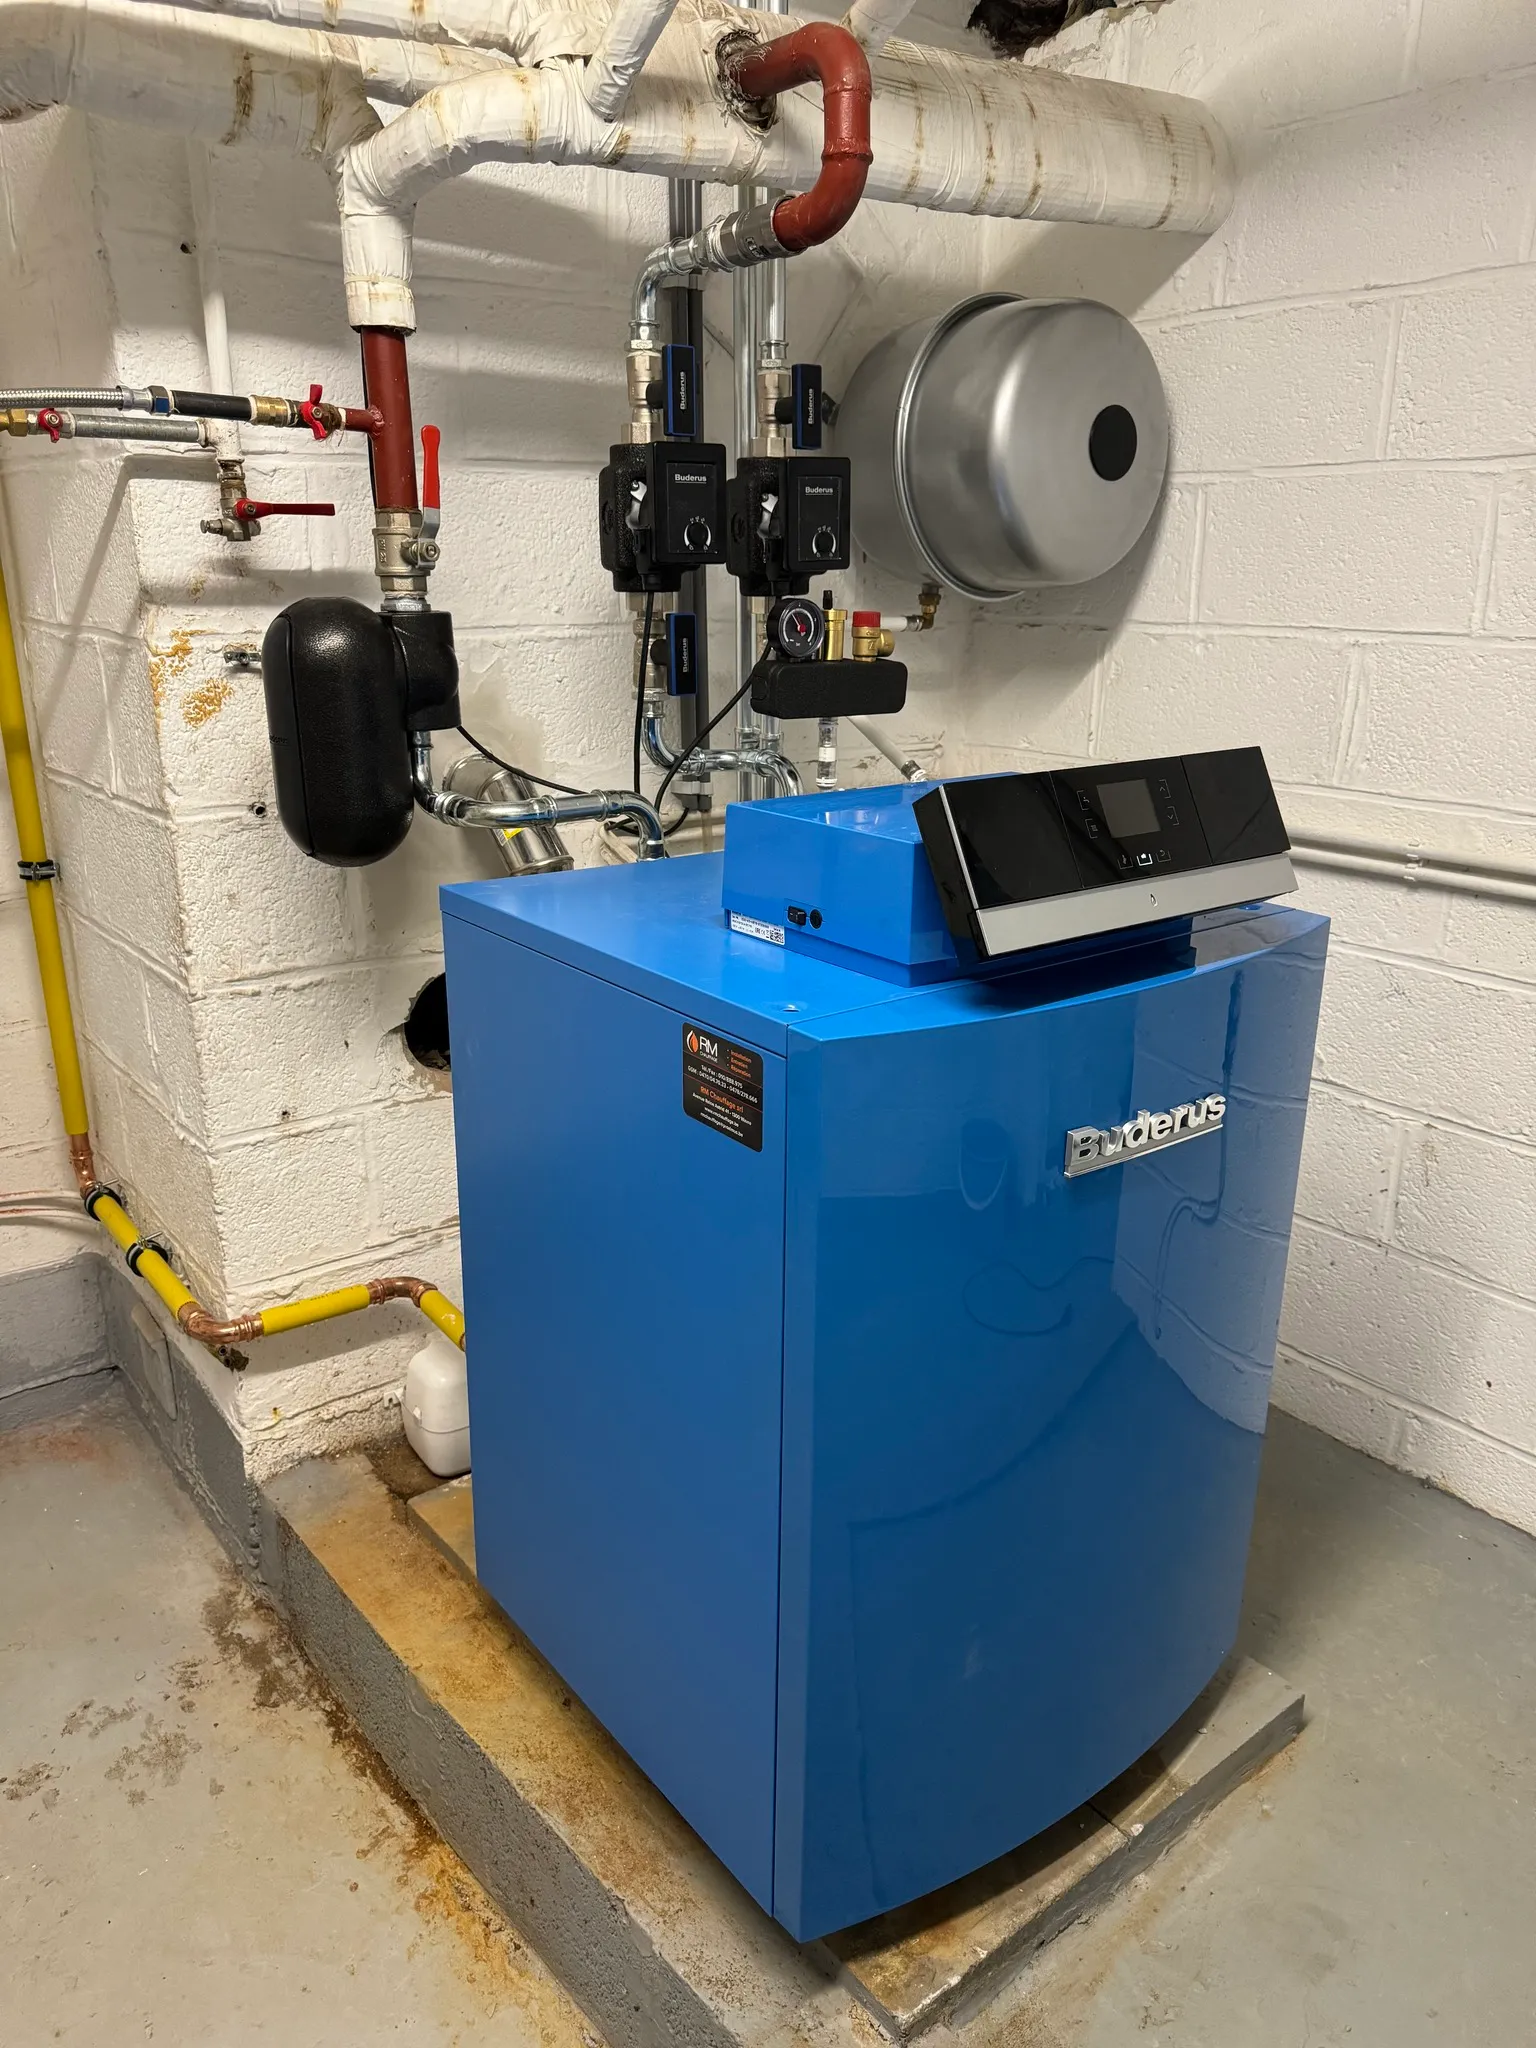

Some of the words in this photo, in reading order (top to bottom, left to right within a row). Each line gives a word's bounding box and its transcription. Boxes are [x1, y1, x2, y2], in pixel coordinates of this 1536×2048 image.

[674, 474, 707, 482] Buderus
[805, 486, 833, 494] Buderus
[700, 1036, 718, 1057] RM
[1065, 1094, 1226, 1167] Buderus
